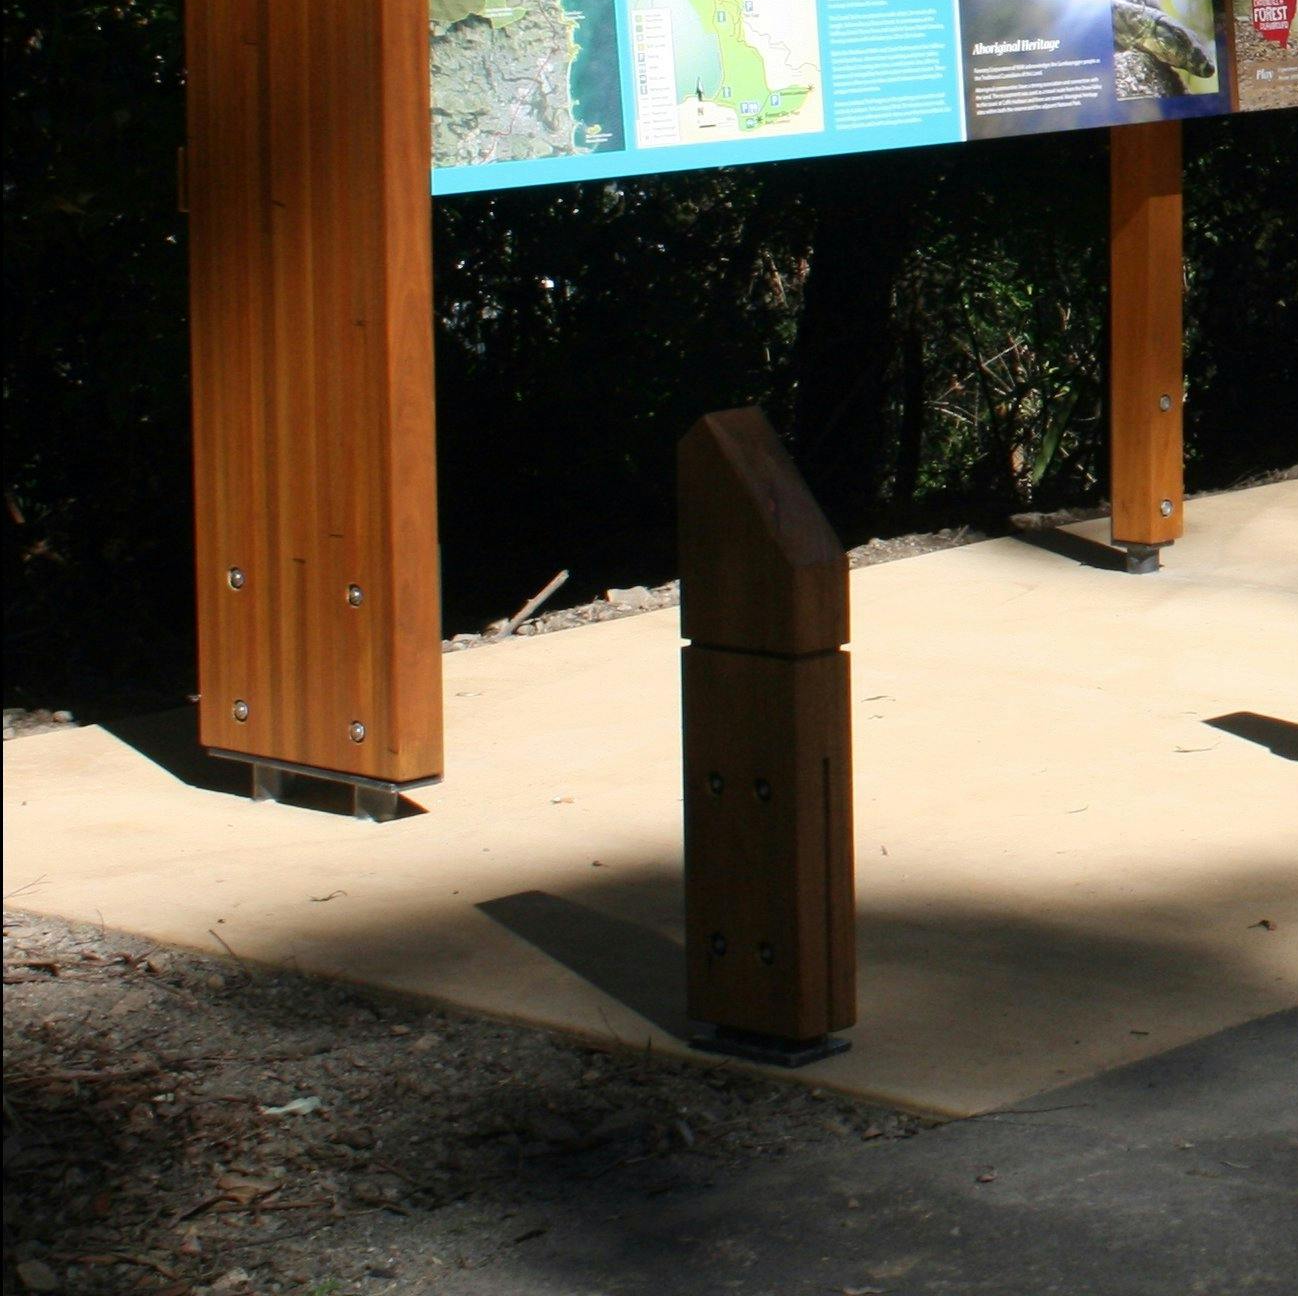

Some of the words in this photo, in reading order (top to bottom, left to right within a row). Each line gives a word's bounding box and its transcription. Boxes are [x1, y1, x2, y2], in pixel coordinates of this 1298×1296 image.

[1253, 6, 1288, 22] FOREST
[972, 39, 1020, 57] Aboriginal
[1021, 38, 1061, 53] Heritage
